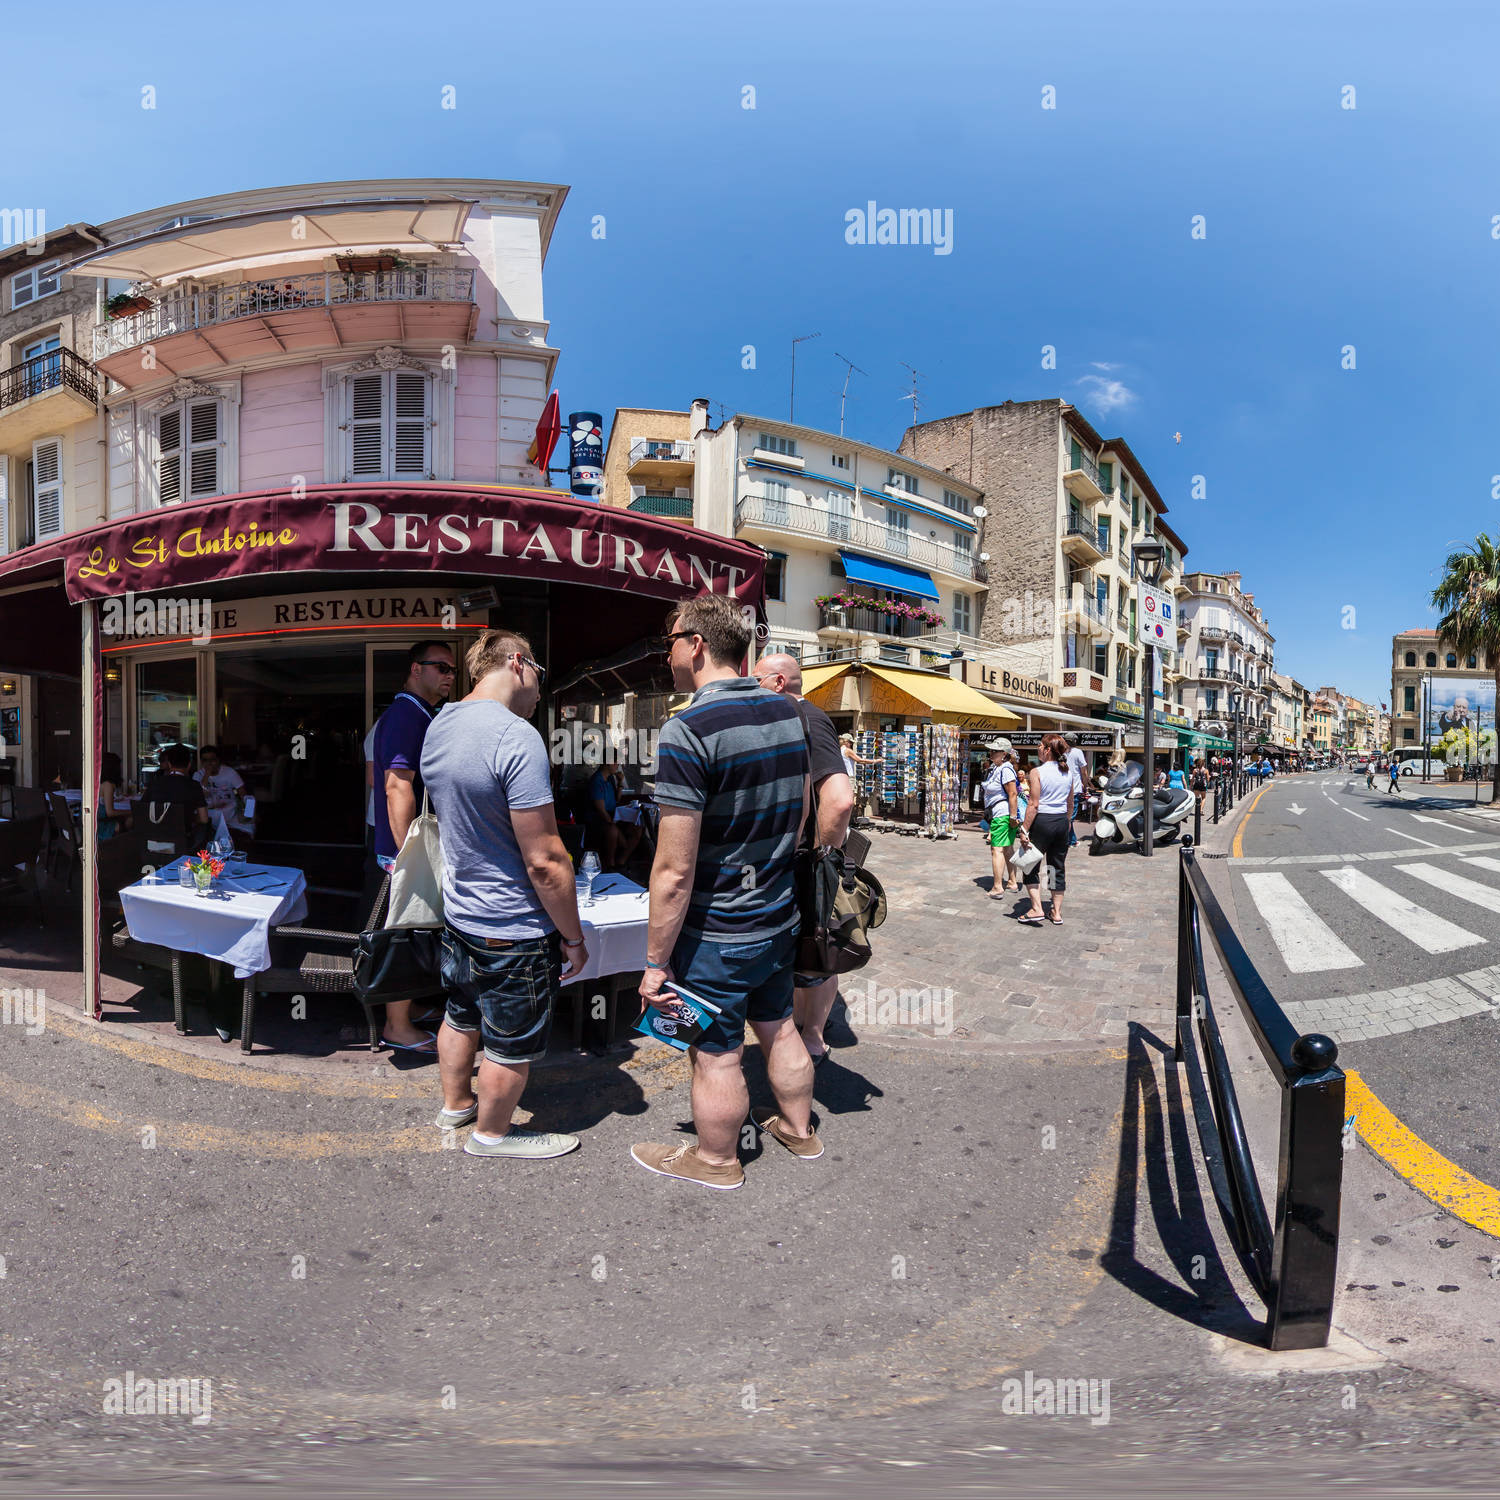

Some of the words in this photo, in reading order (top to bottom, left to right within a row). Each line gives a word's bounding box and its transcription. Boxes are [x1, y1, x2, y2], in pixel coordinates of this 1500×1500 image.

[78, 546, 120, 578] Le
[125, 535, 170, 568] St
[176, 521, 300, 558] Antoine
[982, 665, 996, 686] LE
